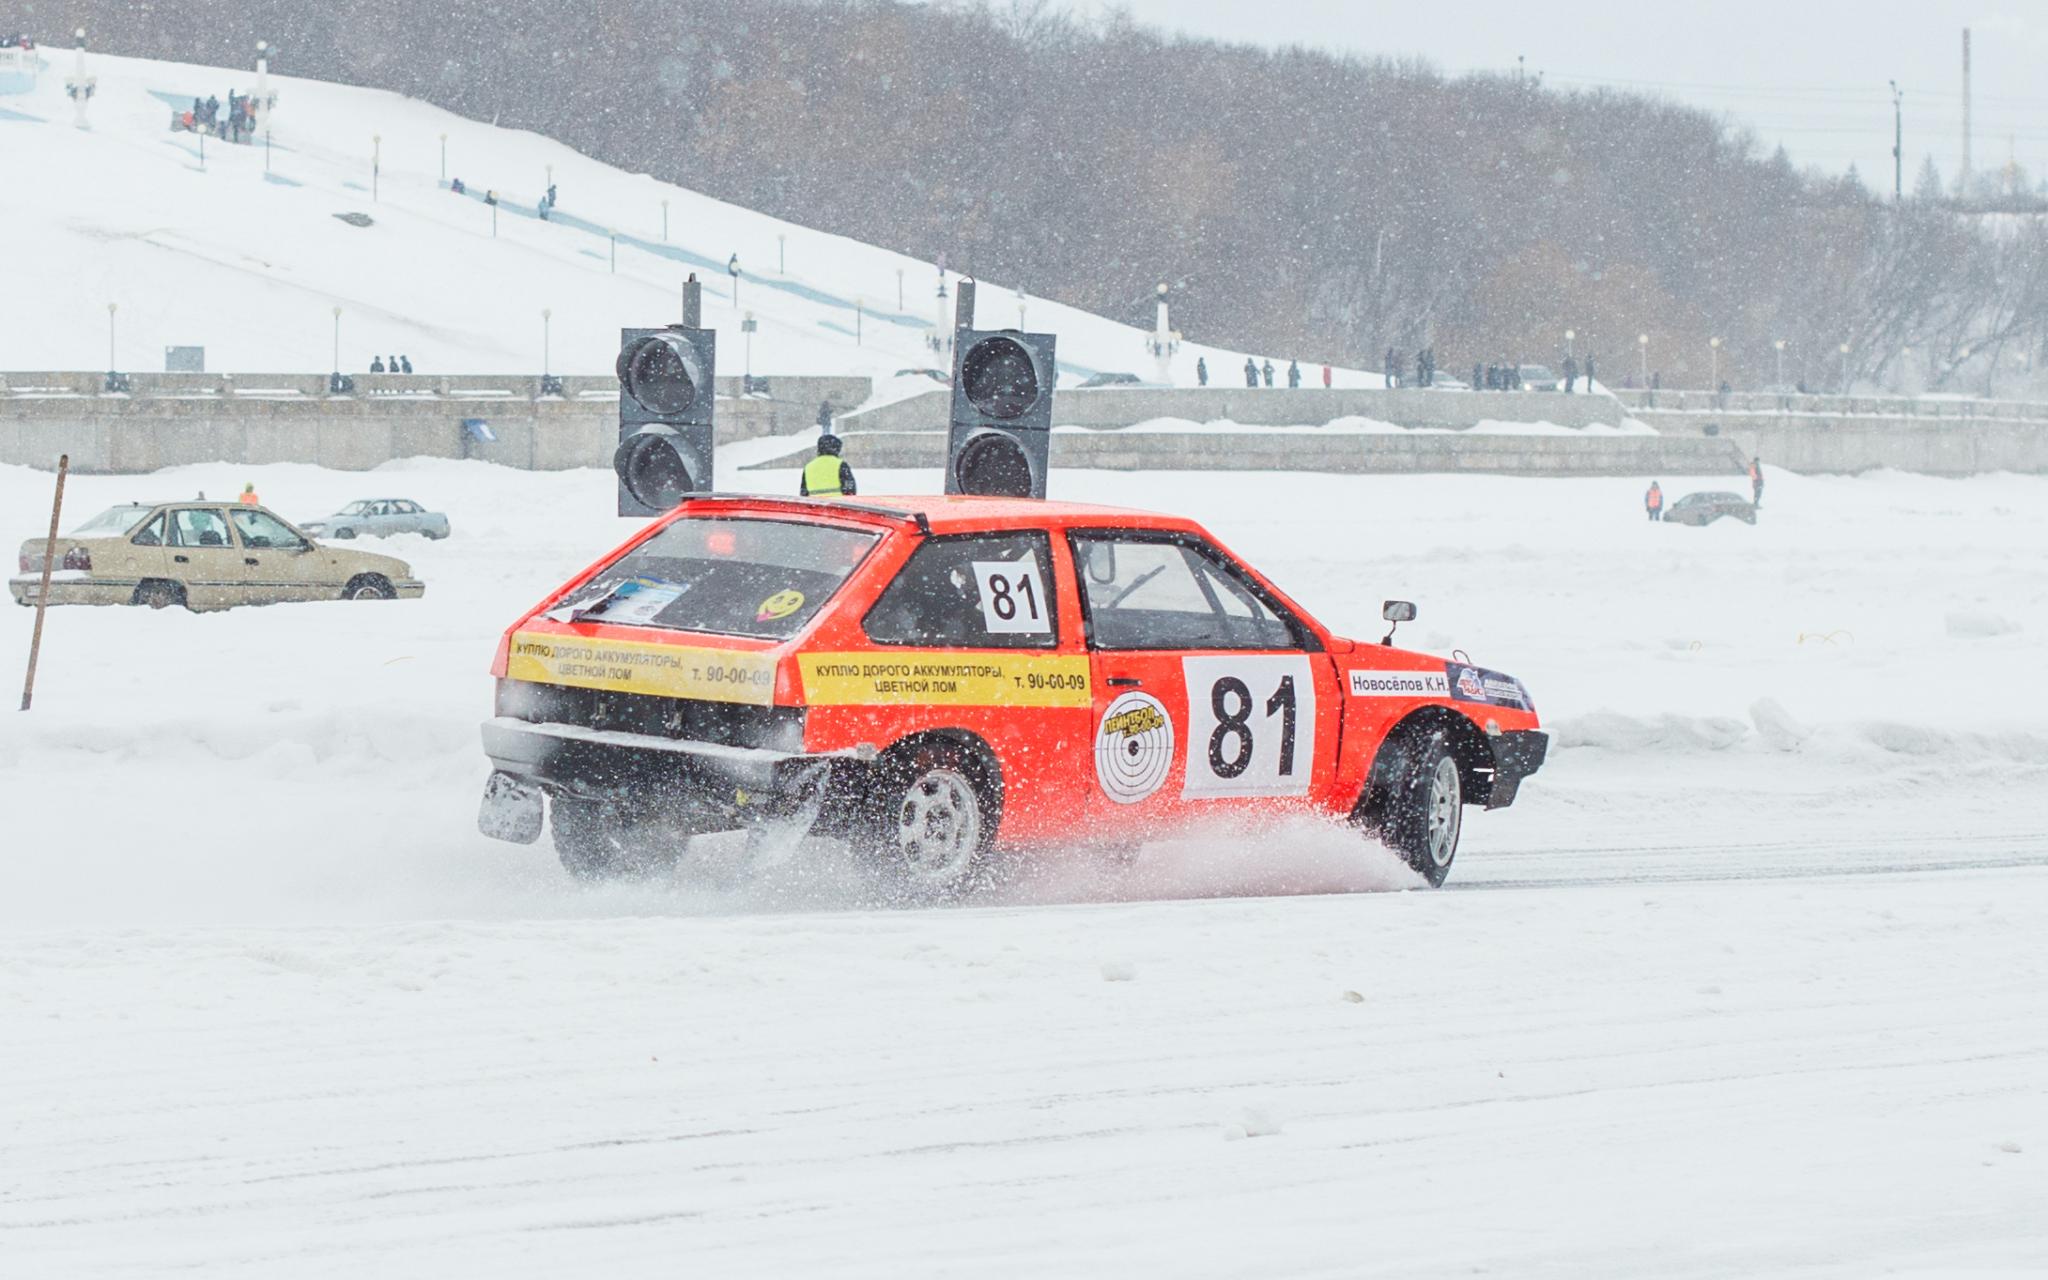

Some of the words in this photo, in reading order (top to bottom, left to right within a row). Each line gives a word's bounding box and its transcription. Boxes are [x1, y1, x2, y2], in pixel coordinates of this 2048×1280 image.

[989, 574, 1039, 620] 81
[516, 643, 551, 657] КУПЛЮ
[552, 646, 592, 662] ДОРОГО
[594, 649, 684, 670] АККУМУЛЯТОРЫ,
[558, 661, 605, 677] ЦВЕТНОЙ
[608, 667, 632, 680] ЛОМ
[706, 665, 771, 685] 90-00-09
[816, 664, 859, 677] КУПЛЮ
[863, 664, 910, 678] ДОРОГО
[913, 664, 1005, 679] АККУМУЛЯТОРЫ,
[875, 679, 929, 693] ЦВЕТНОЙ
[932, 681, 957, 693] ЛОМ
[1353, 675, 1423, 691] Новосёлов
[1104, 704, 1155, 735] ПЕЙНТБОЛ
[1208, 675, 1296, 779] 81
